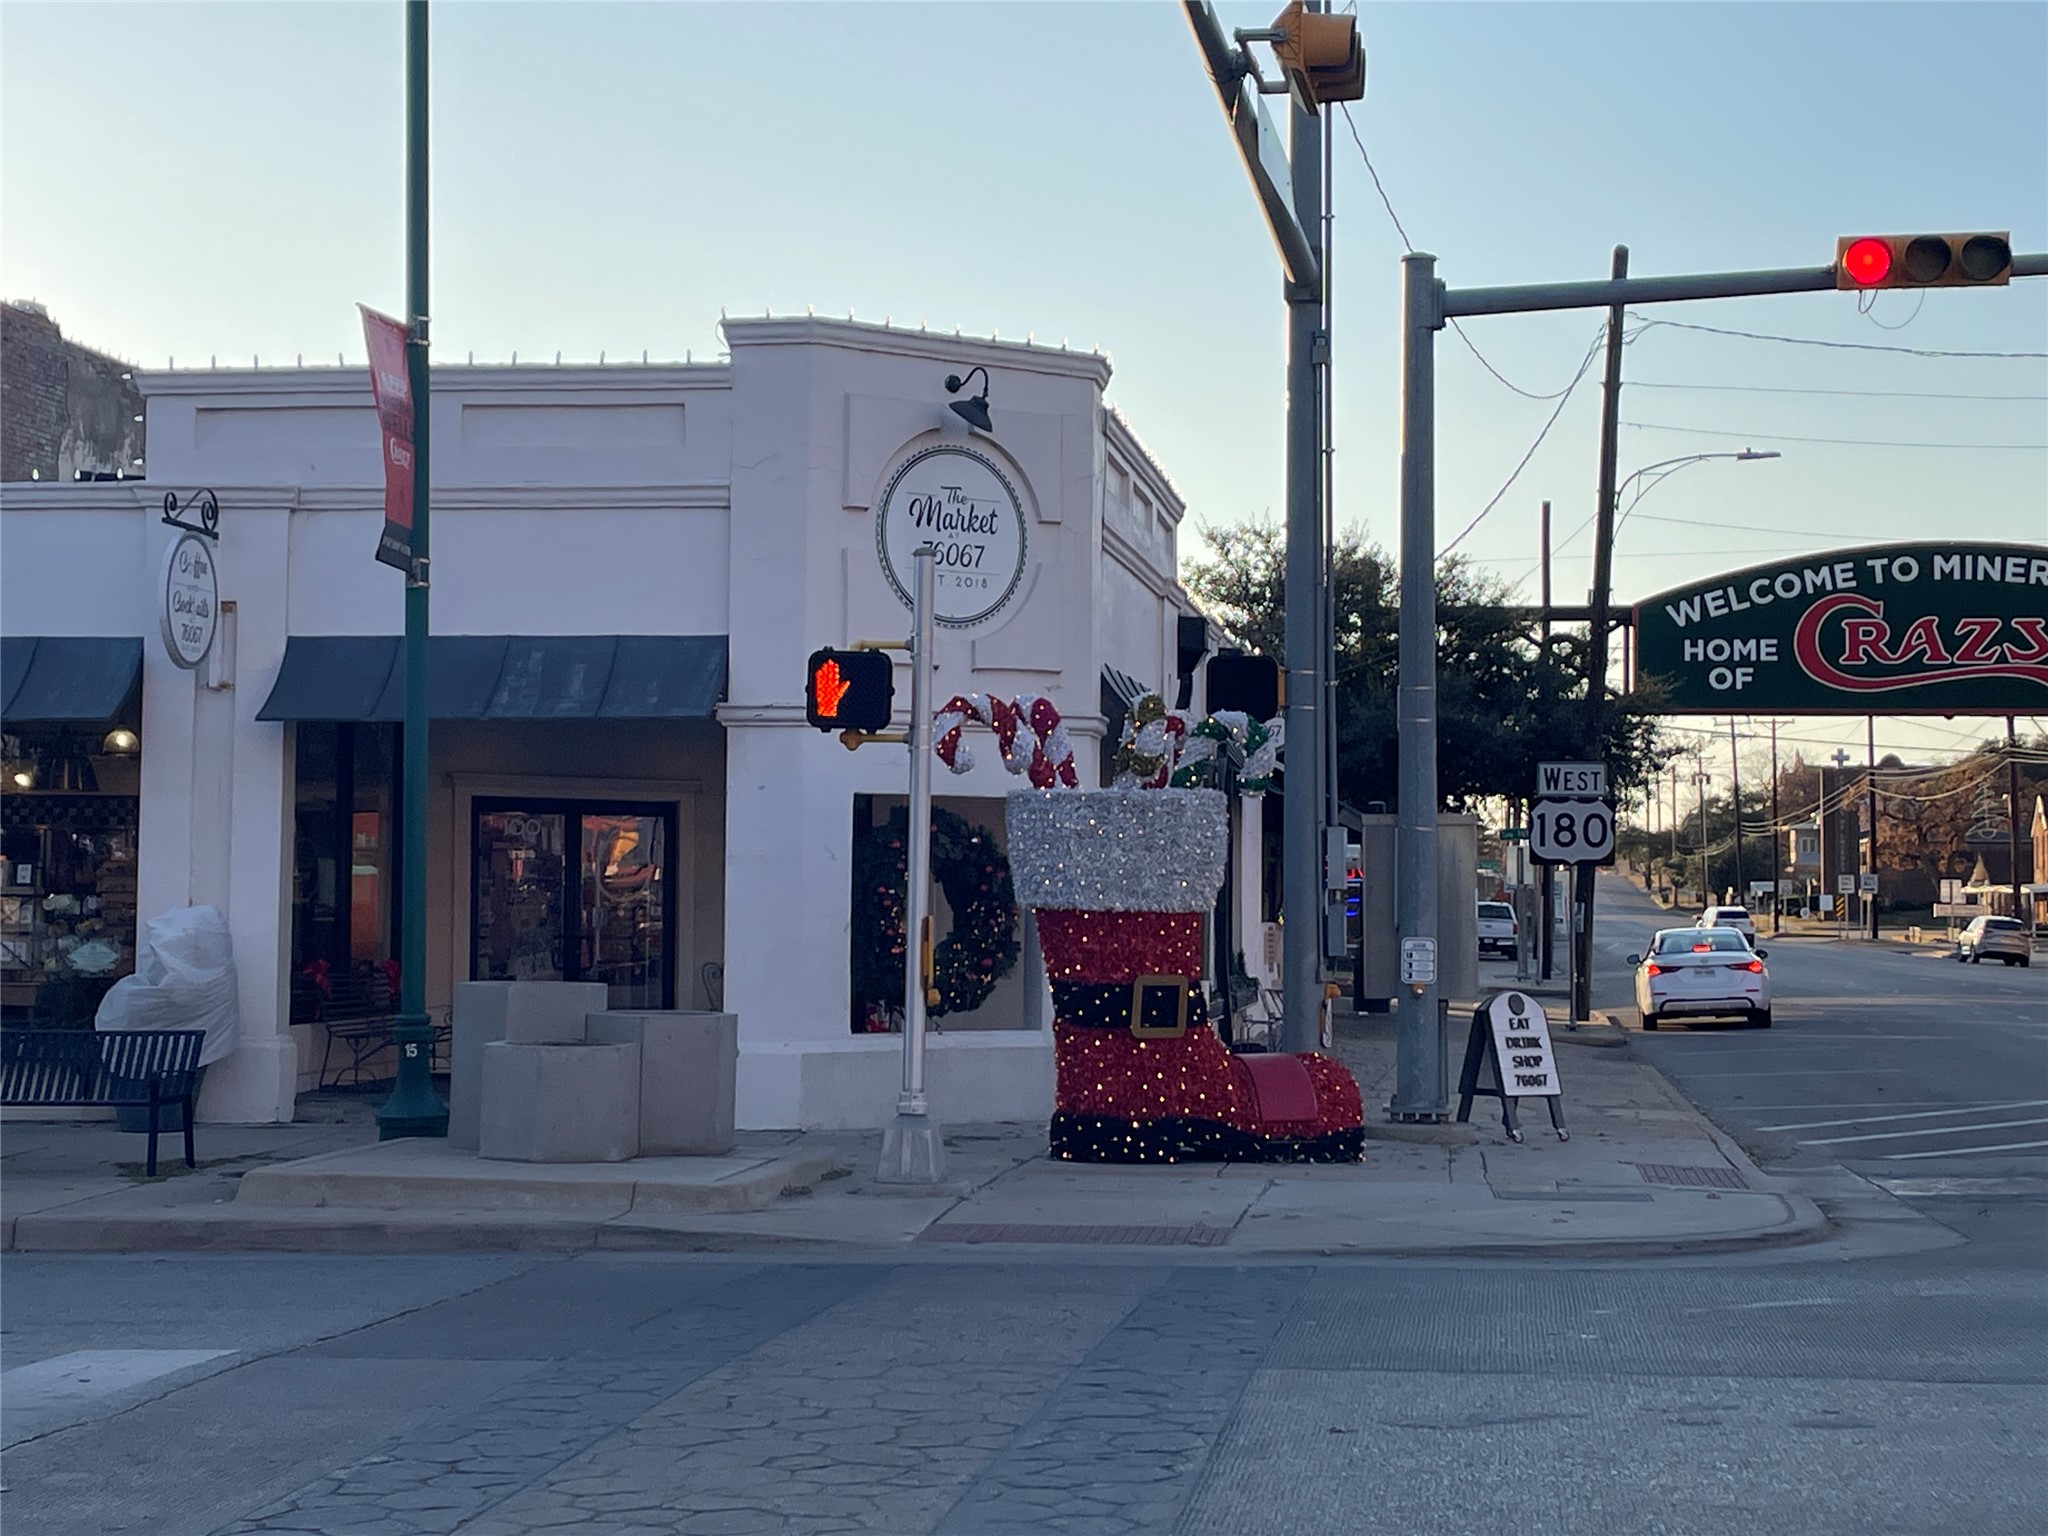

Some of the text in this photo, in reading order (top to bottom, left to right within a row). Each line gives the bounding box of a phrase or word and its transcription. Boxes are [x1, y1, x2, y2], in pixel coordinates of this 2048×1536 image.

[941, 485, 969, 505] The
[909, 495, 999, 535] Market
[955, 577, 988, 589] 2018
[1665, 554, 2048, 628] WELCOME TO MINER
[1684, 638, 1779, 662] HOME
[1708, 666, 1754, 691] OF
[1543, 767, 1601, 791] WEST
[1537, 812, 1608, 849] 180
[1508, 1018, 1530, 1030] EAT
[404, 1043, 418, 1058] 15
[1505, 1036, 1542, 1049] DRINK
[1512, 1055, 1543, 1069] SHOP
